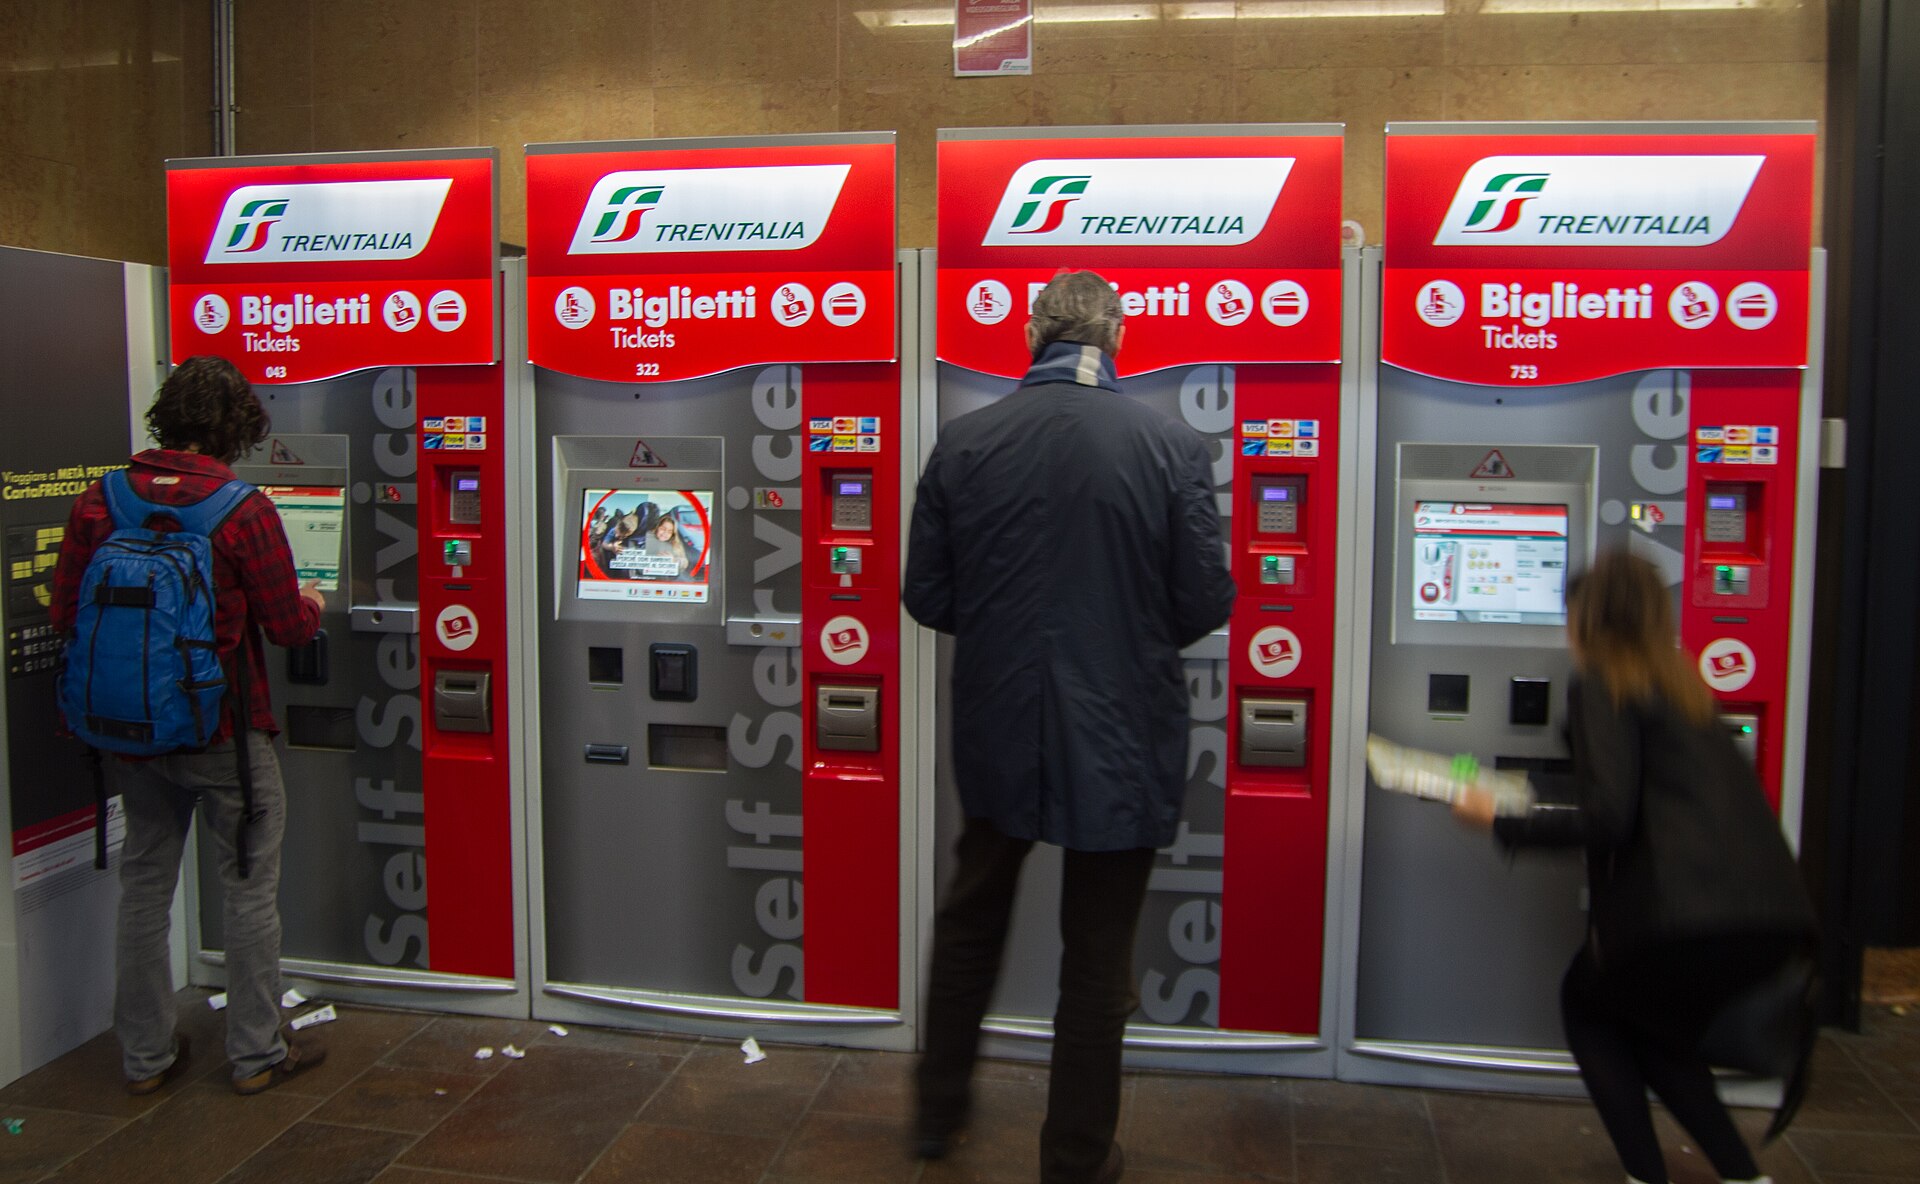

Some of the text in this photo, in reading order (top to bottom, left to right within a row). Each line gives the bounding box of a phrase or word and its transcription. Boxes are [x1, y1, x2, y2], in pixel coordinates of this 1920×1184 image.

[655, 221, 805, 242] TRENITALIA
[1081, 216, 1244, 235] TRENITALIA
[1538, 215, 1711, 235] TRENITALIA
[281, 232, 413, 254] TRENITALIA
[242, 294, 371, 333] Biglietti
[609, 286, 756, 328] Biglietti
[1481, 282, 1653, 327] Biglietti
[243, 332, 300, 353] Tickets
[610, 327, 675, 348] Tickets
[1481, 326, 1558, 349] Tickets
[266, 366, 287, 379] 043
[636, 364, 660, 376] 322
[1510, 365, 1538, 379] 753
[2, 471, 47, 485] Viaggiare
[57, 465, 85, 480] METÀ
[3, 481, 88, 500] CartaFRECCIA
[356, 777, 431, 970] Self
[725, 799, 804, 999] Self
